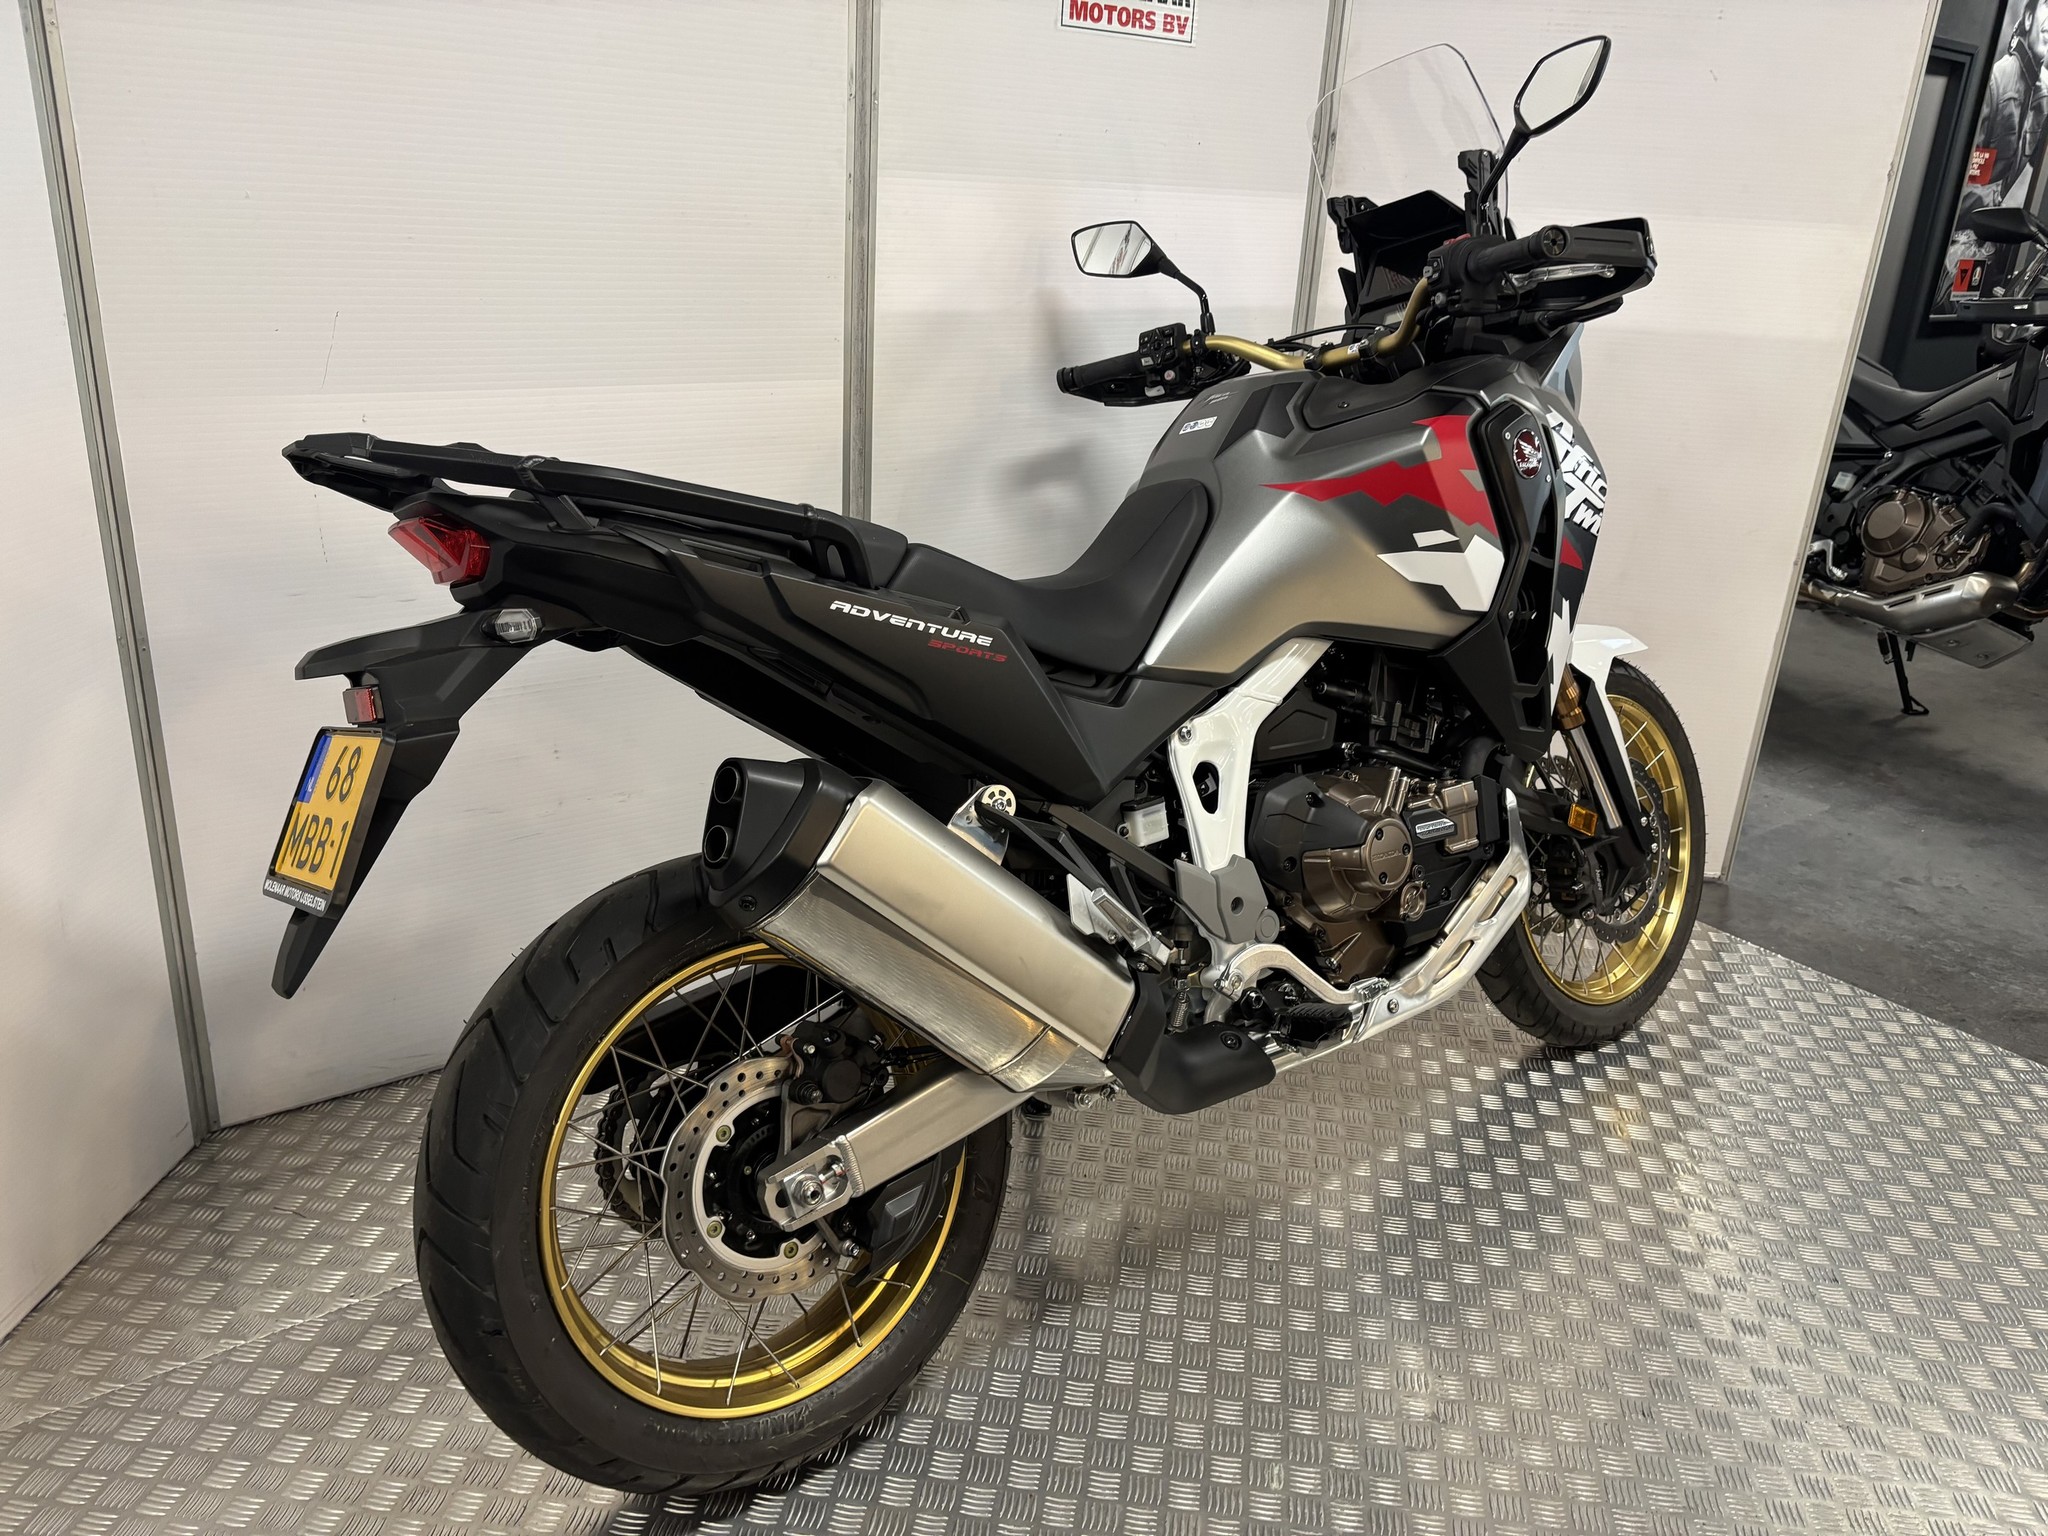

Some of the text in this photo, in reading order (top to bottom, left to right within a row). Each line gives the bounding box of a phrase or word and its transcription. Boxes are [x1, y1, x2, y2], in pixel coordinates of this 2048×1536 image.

[1069, 0, 1189, 35] MOTORS BV
[829, 600, 993, 647] ADVENTURE
[927, 639, 1007, 663] SPORTS
[325, 745, 363, 803] 68
